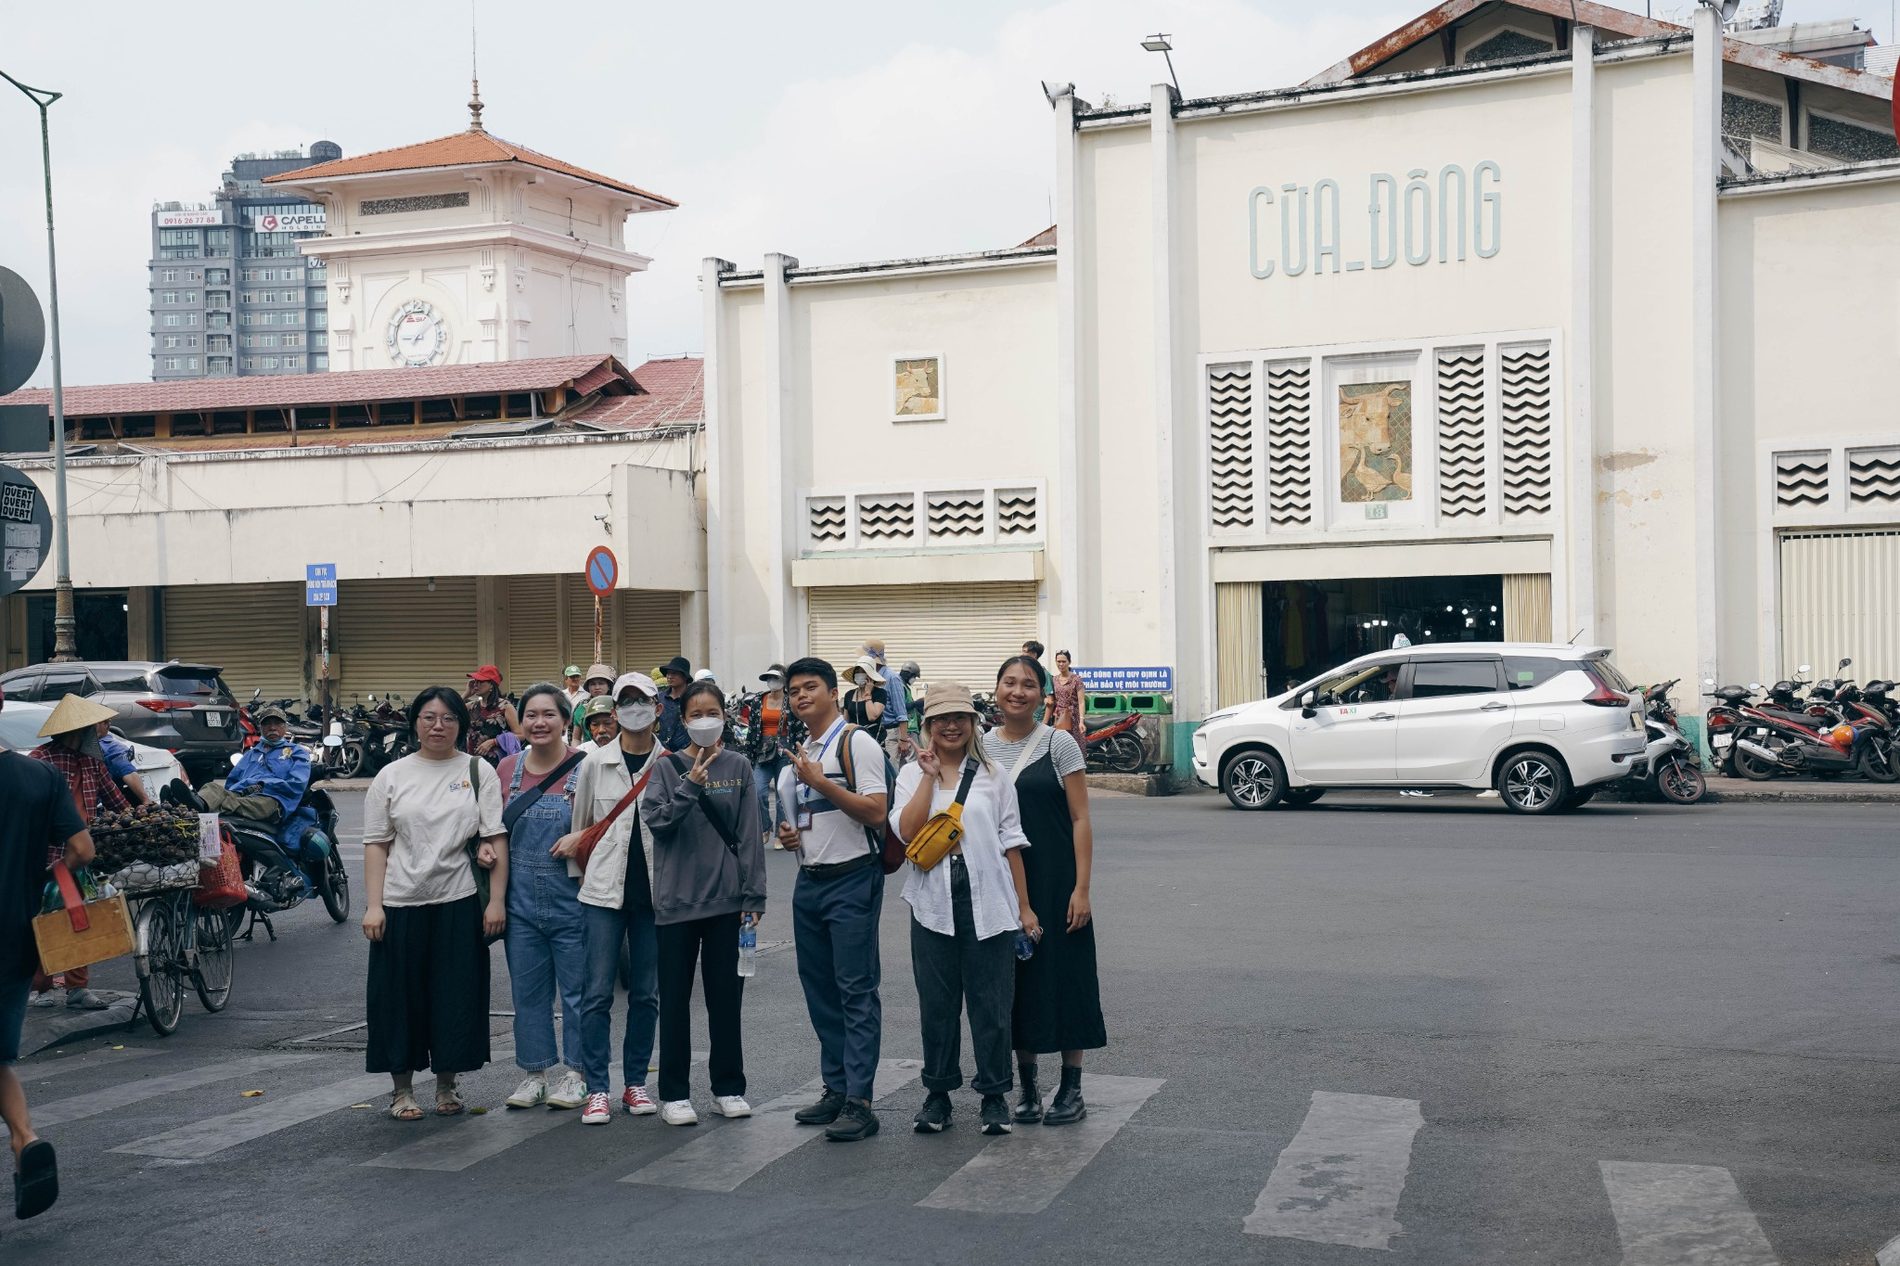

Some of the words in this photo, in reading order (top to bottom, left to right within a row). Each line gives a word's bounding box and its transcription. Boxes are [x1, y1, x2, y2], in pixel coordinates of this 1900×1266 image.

[4, 487, 33, 500] OVERT
[3, 496, 32, 509] OVERT
[2, 506, 31, 519] OVERT
[1159, 669, 1168, 678] LÀ
